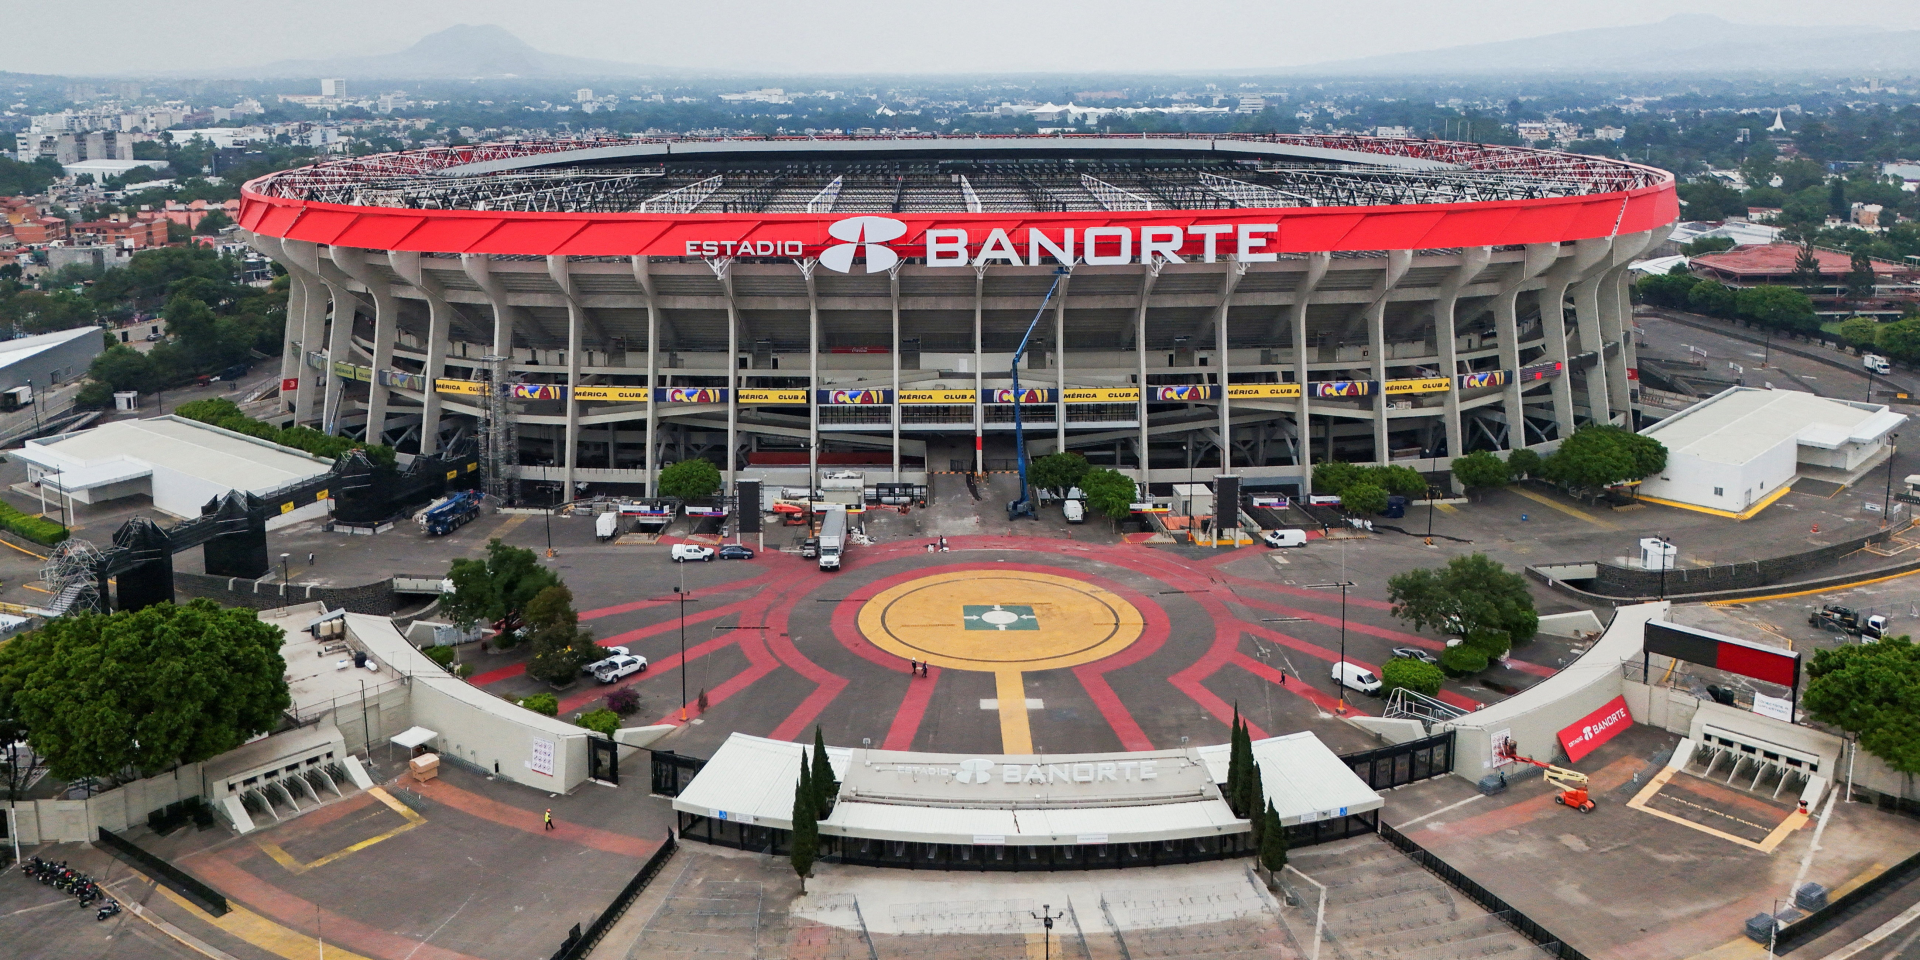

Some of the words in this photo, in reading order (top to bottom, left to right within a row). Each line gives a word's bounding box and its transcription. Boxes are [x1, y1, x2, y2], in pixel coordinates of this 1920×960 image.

[685, 240, 803, 256] ESTADIO
[926, 223, 1278, 268] BANORTE
[1591, 707, 1626, 735] BANORTE
[1002, 760, 1158, 783] BANORTE
